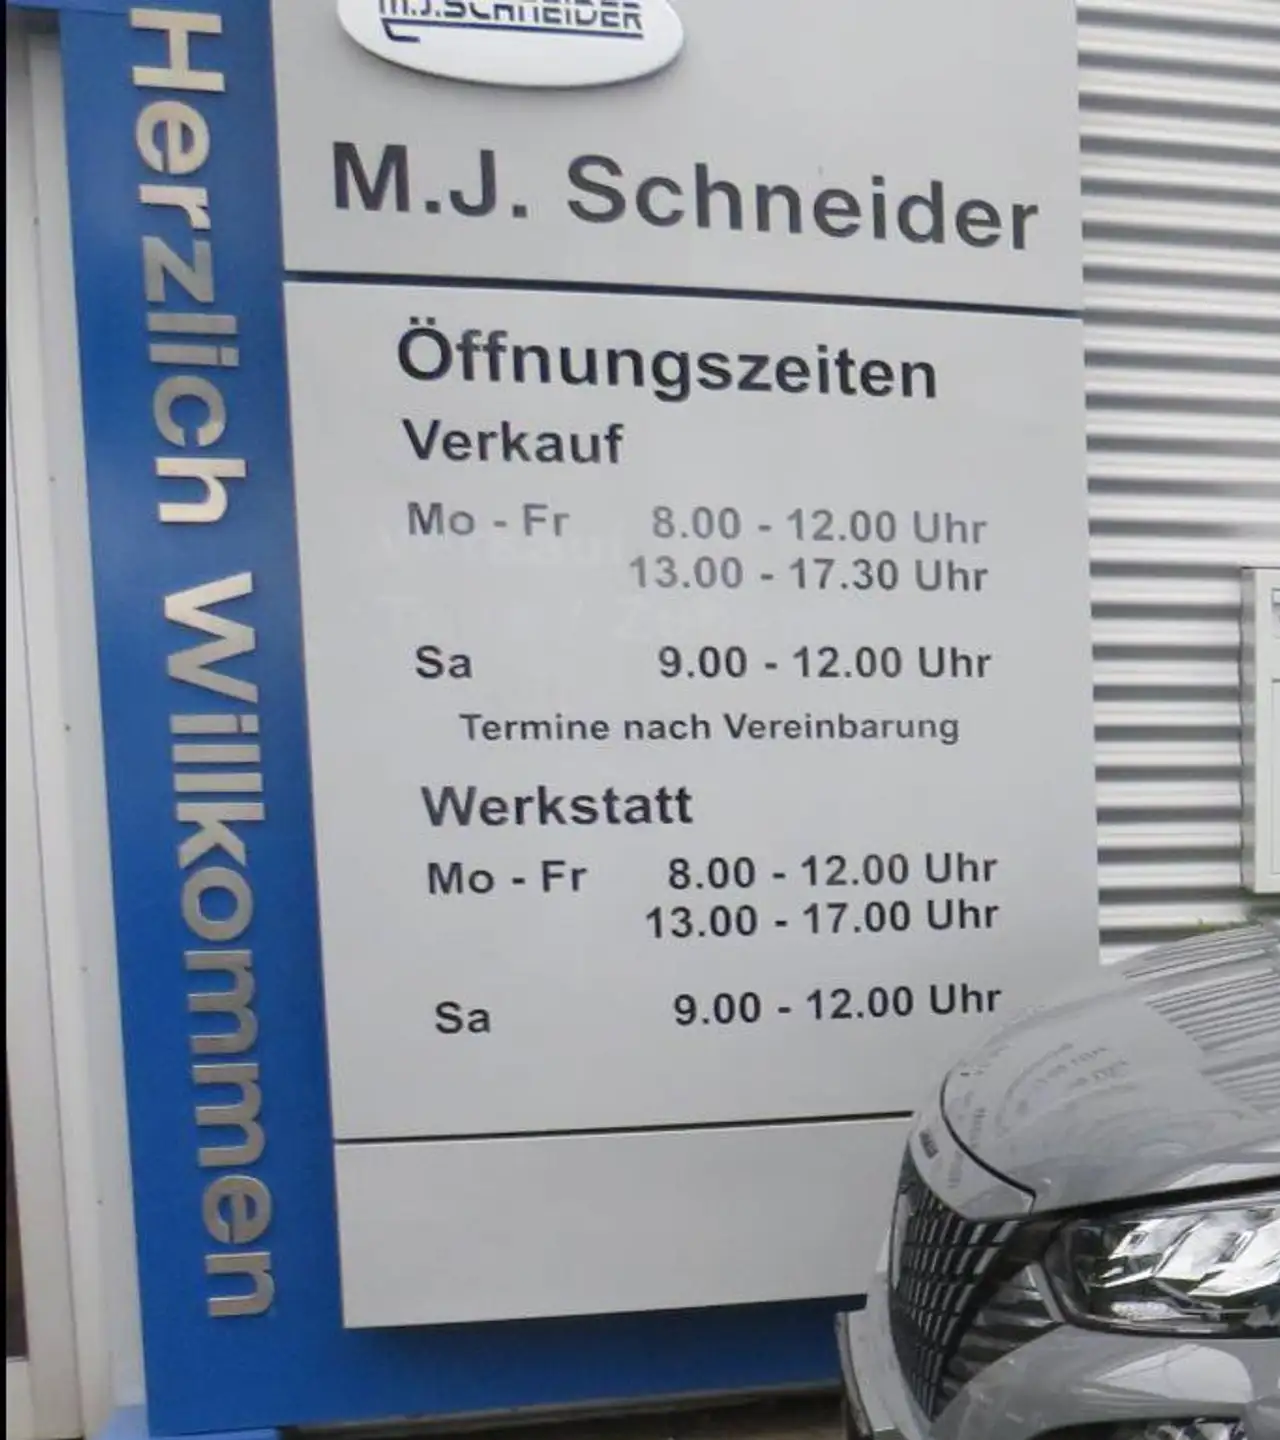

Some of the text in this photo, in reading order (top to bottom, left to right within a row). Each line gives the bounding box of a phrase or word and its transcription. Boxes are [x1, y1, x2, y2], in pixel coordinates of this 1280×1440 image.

[333, 141, 1039, 250] M.J. Schneider
[397, 316, 936, 402] Öffnungszeiten
[402, 418, 624, 464] Verkauf
[407, 501, 474, 537] Mo
[523, 503, 570, 537] Fr
[652, 505, 741, 540] 8.00
[787, 508, 897, 543] 12.00
[913, 510, 987, 544] Uhr
[629, 555, 743, 589] 13.00
[790, 557, 899, 591] 17.30
[915, 559, 989, 592] Uhr
[128, 7, 276, 1318] Herzlich Willkommen
[416, 645, 472, 679] Sa
[659, 645, 747, 678] 9.00
[793, 645, 902, 678] 12.00
[918, 646, 991, 678] Uhr
[459, 713, 959, 746] Termine nach Vereinbarung
[421, 785, 693, 827] Werkstatt
[428, 861, 495, 895] Mo
[541, 860, 587, 893] Fr
[668, 856, 755, 890] 8.00
[801, 853, 909, 886] 12.00
[925, 852, 998, 884] Uhr
[646, 904, 758, 939] 13.00
[803, 900, 911, 934] 17.00
[927, 898, 999, 931] Uhr
[435, 1001, 490, 1034] Sa
[674, 991, 761, 1026] 9.00
[807, 985, 914, 1020] 12.00
[930, 983, 1002, 1015] Uhr
